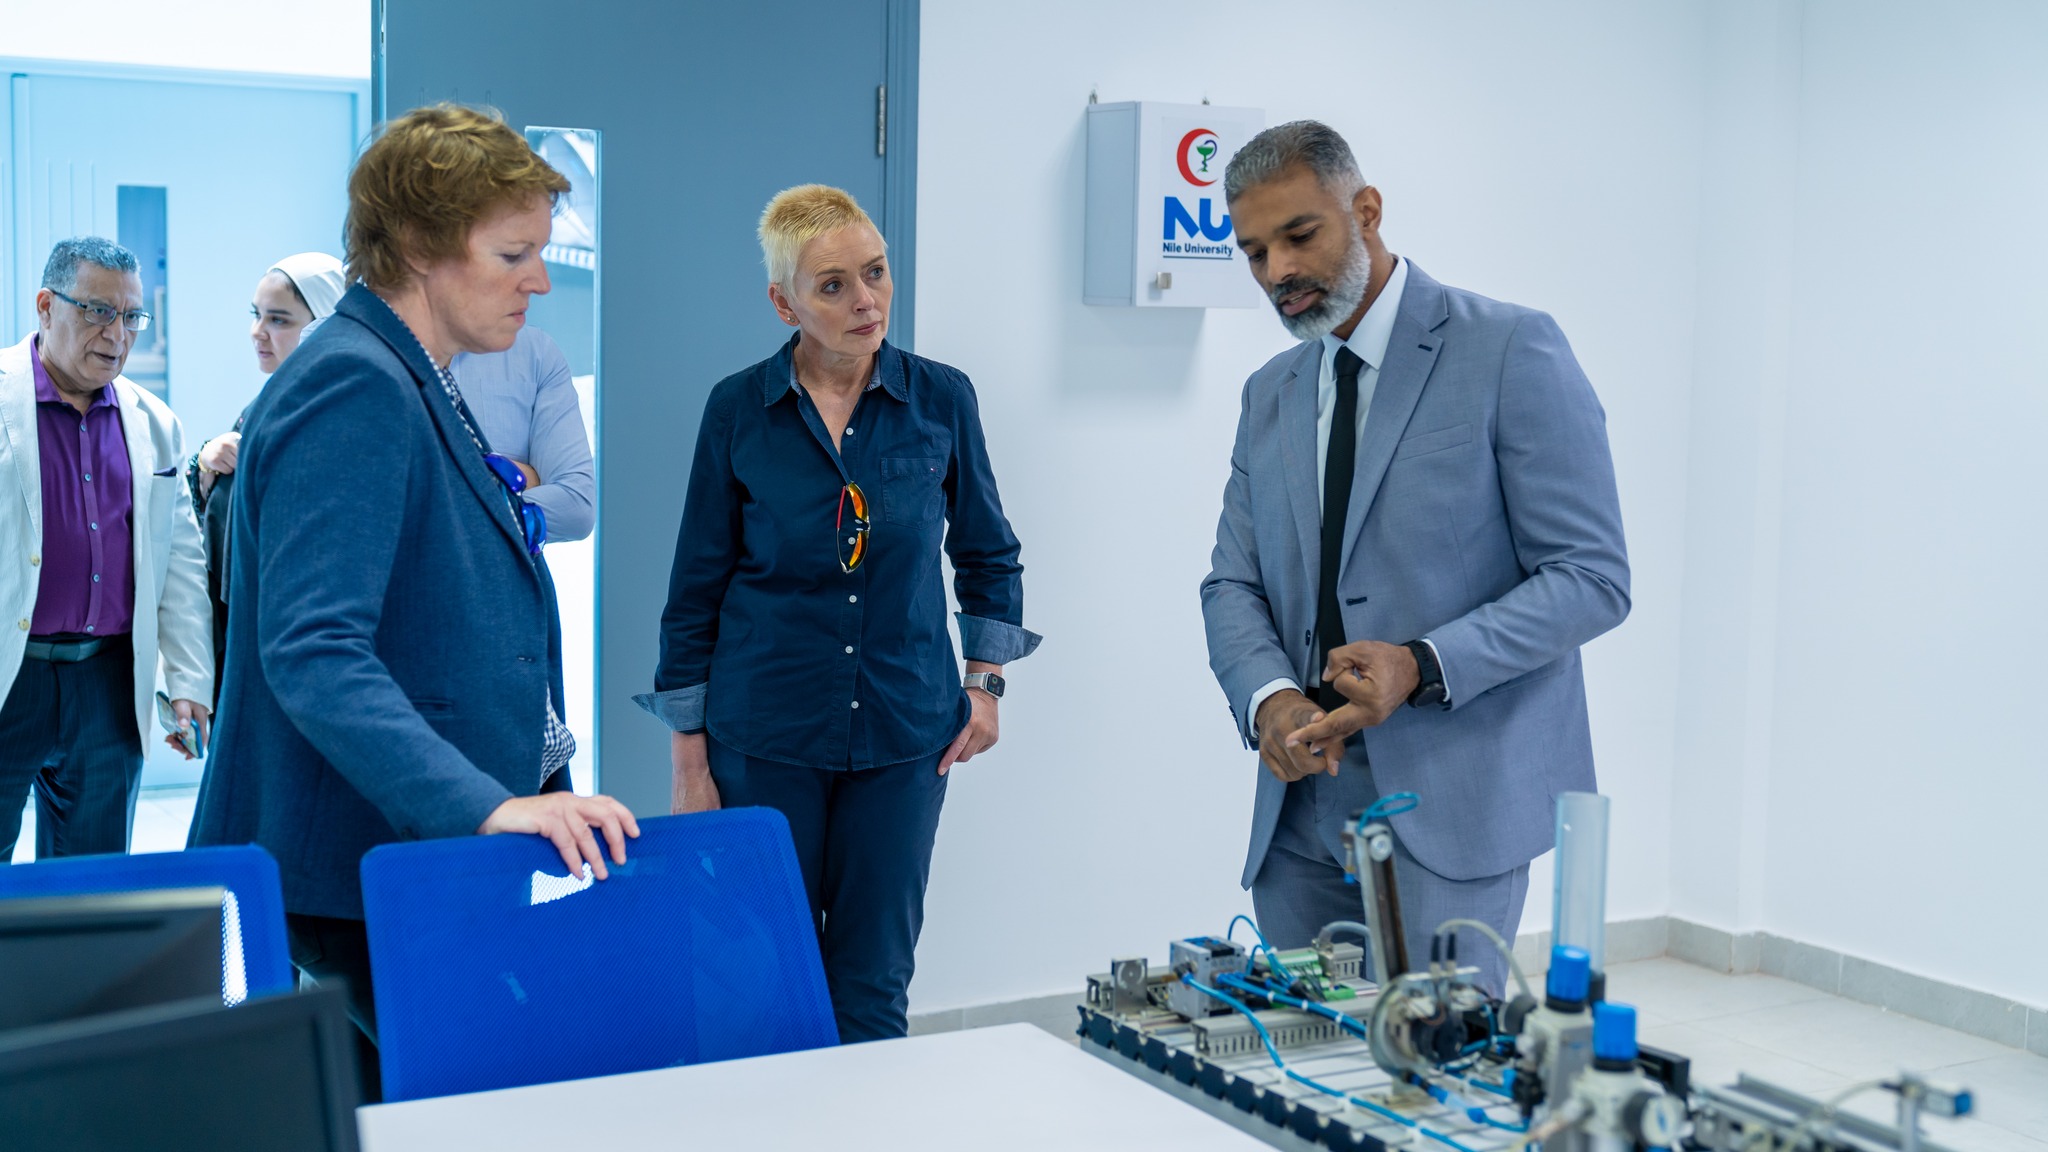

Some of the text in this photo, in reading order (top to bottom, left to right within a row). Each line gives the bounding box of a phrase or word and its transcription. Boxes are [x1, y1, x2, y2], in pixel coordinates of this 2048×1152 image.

[1163, 196, 1233, 241] NU
[1163, 242, 1233, 257] Nile University
